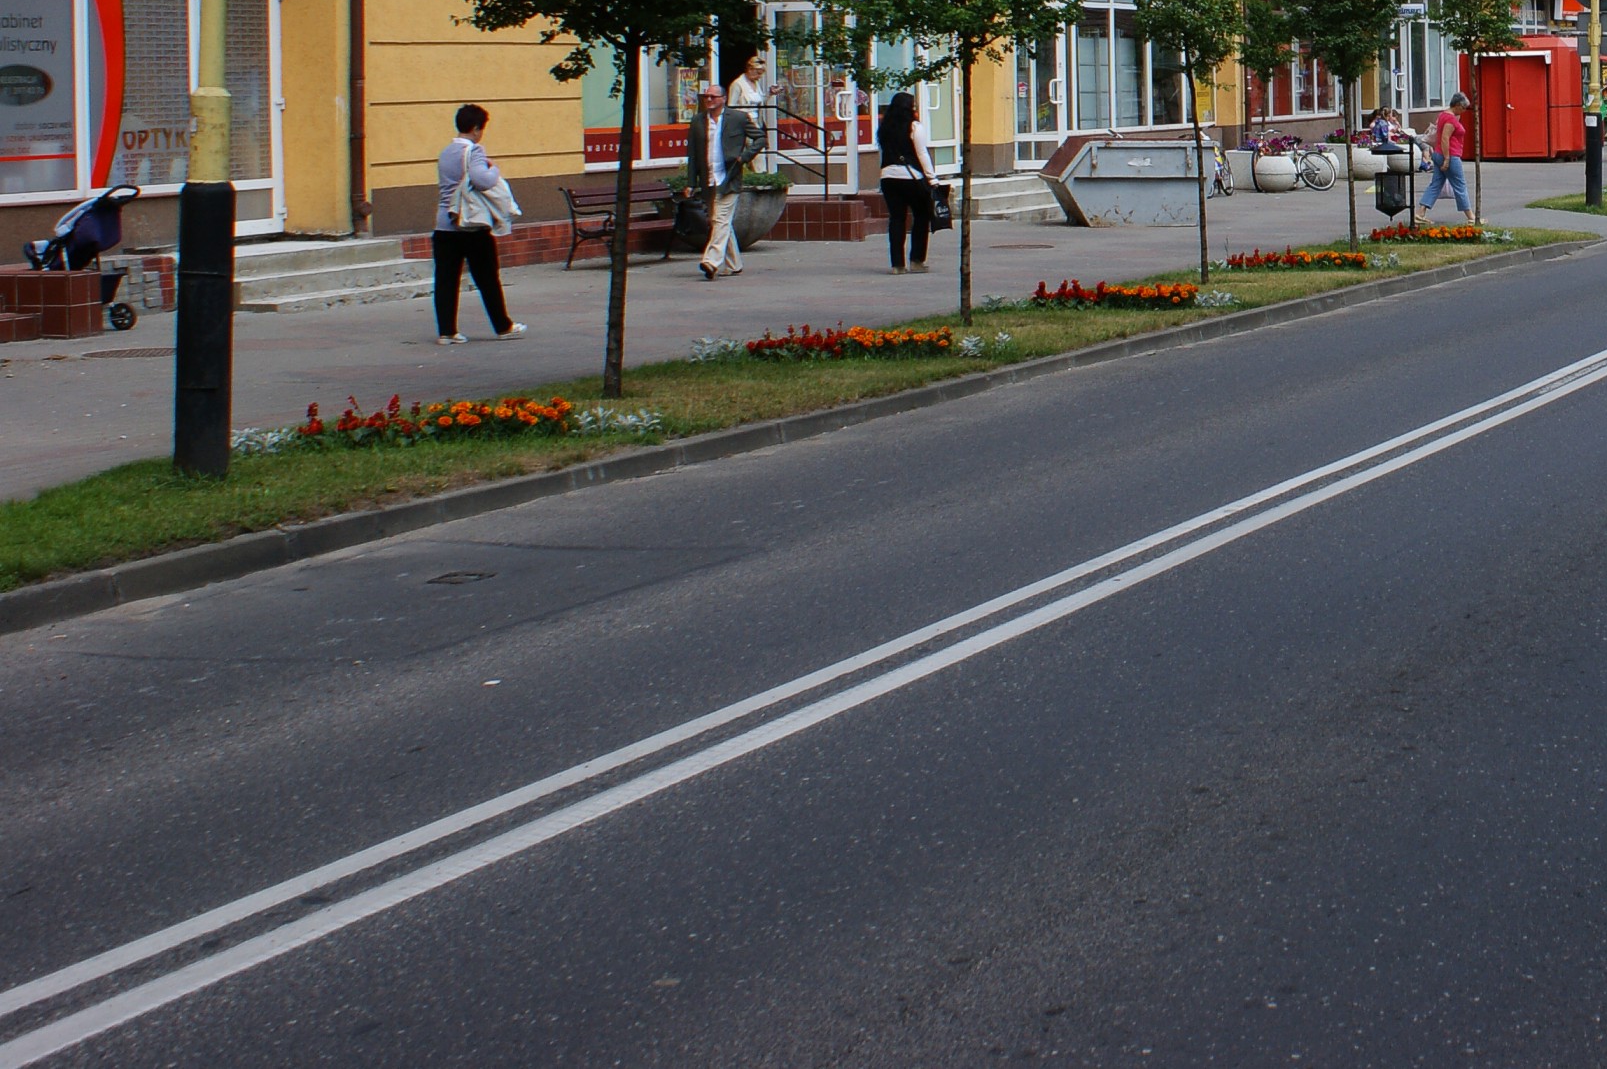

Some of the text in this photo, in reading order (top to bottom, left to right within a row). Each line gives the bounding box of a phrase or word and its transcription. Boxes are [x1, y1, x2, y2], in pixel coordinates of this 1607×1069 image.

[1, 13, 43, 29] abinet
[122, 127, 188, 150] OPTYK
[587, 139, 688, 153] warzy owo
